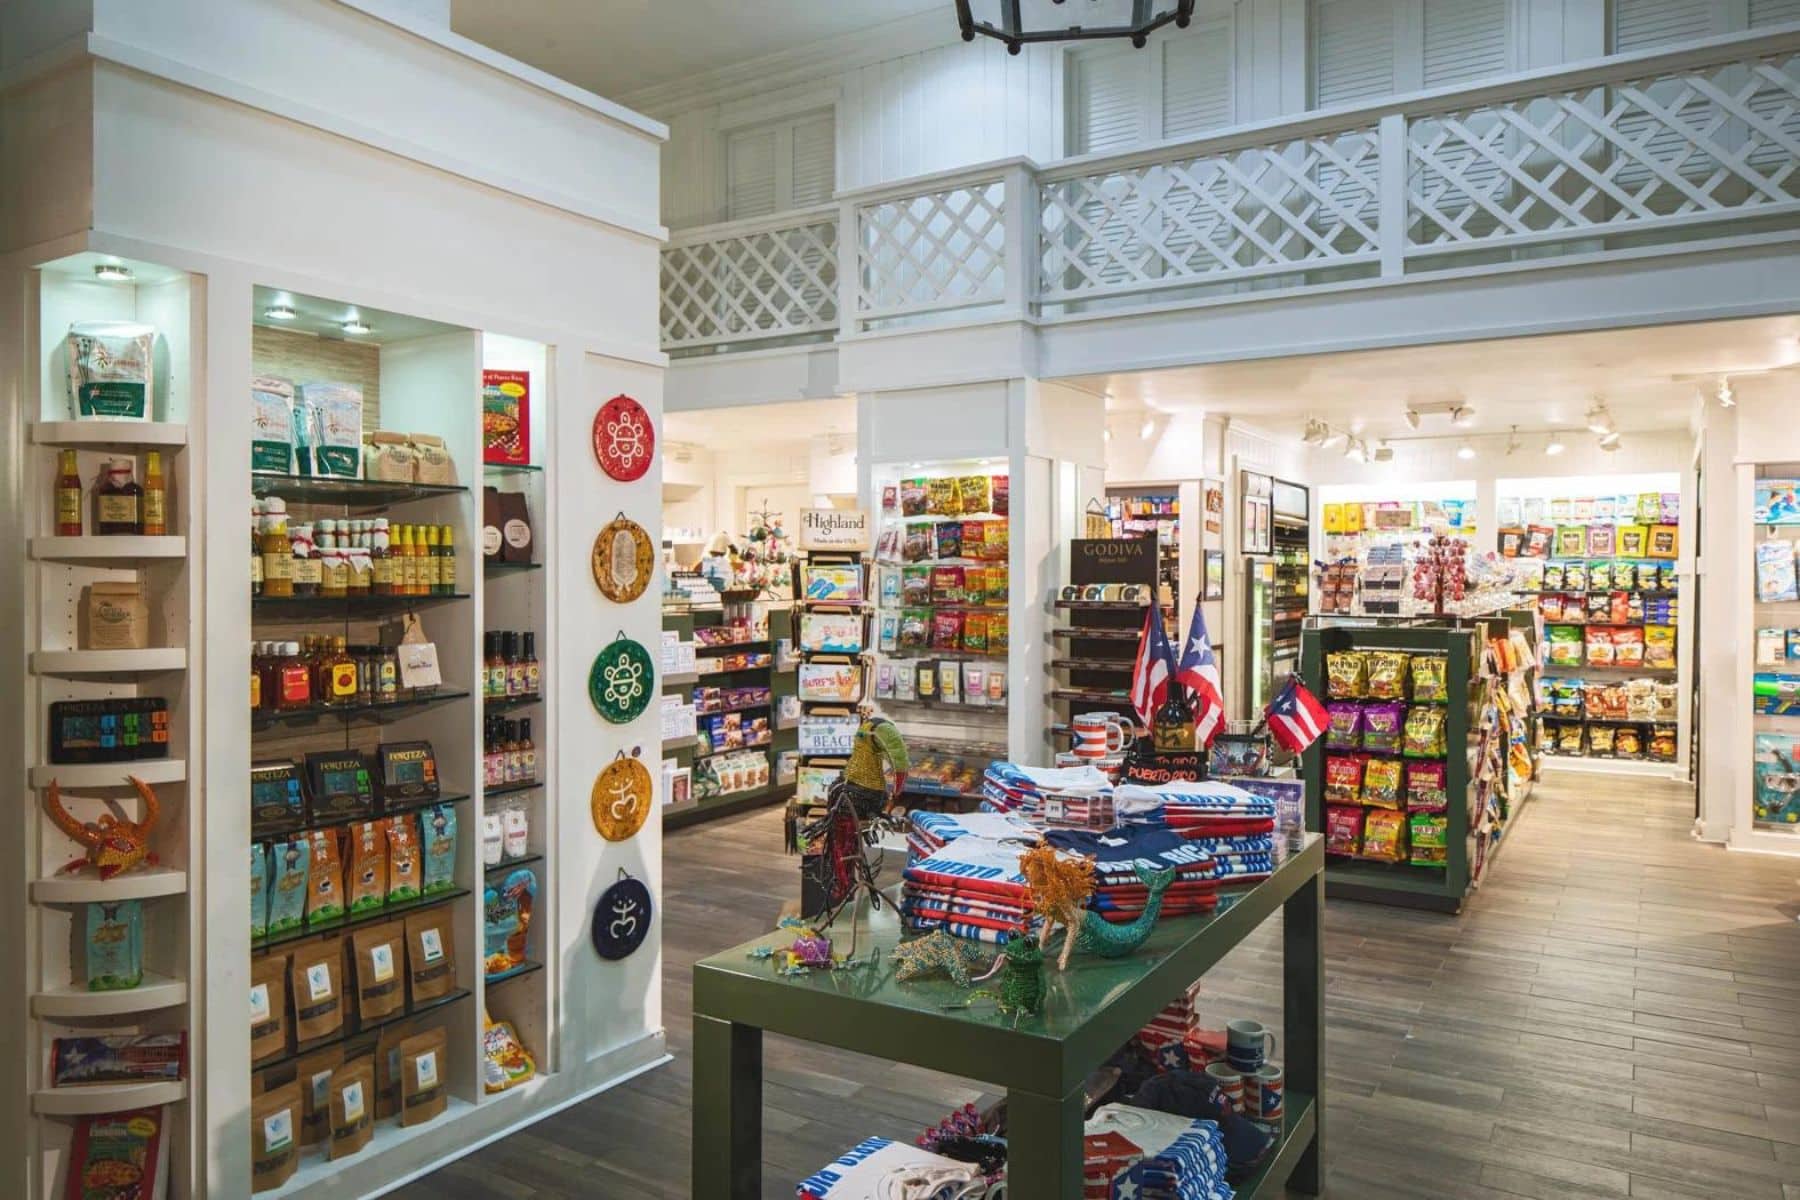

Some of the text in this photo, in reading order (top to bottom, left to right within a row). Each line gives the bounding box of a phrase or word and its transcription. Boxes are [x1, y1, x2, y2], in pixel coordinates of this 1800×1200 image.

[803, 512, 864, 535] Highland
[1083, 543, 1143, 556] GODIVA
[1414, 663, 1442, 672] HARIBO
[389, 751, 427, 761] FORTEZA
[320, 760, 361, 771] FORTEZA
[1128, 766, 1170, 781] PUERTO
[919, 858, 1004, 879] PUERTO
